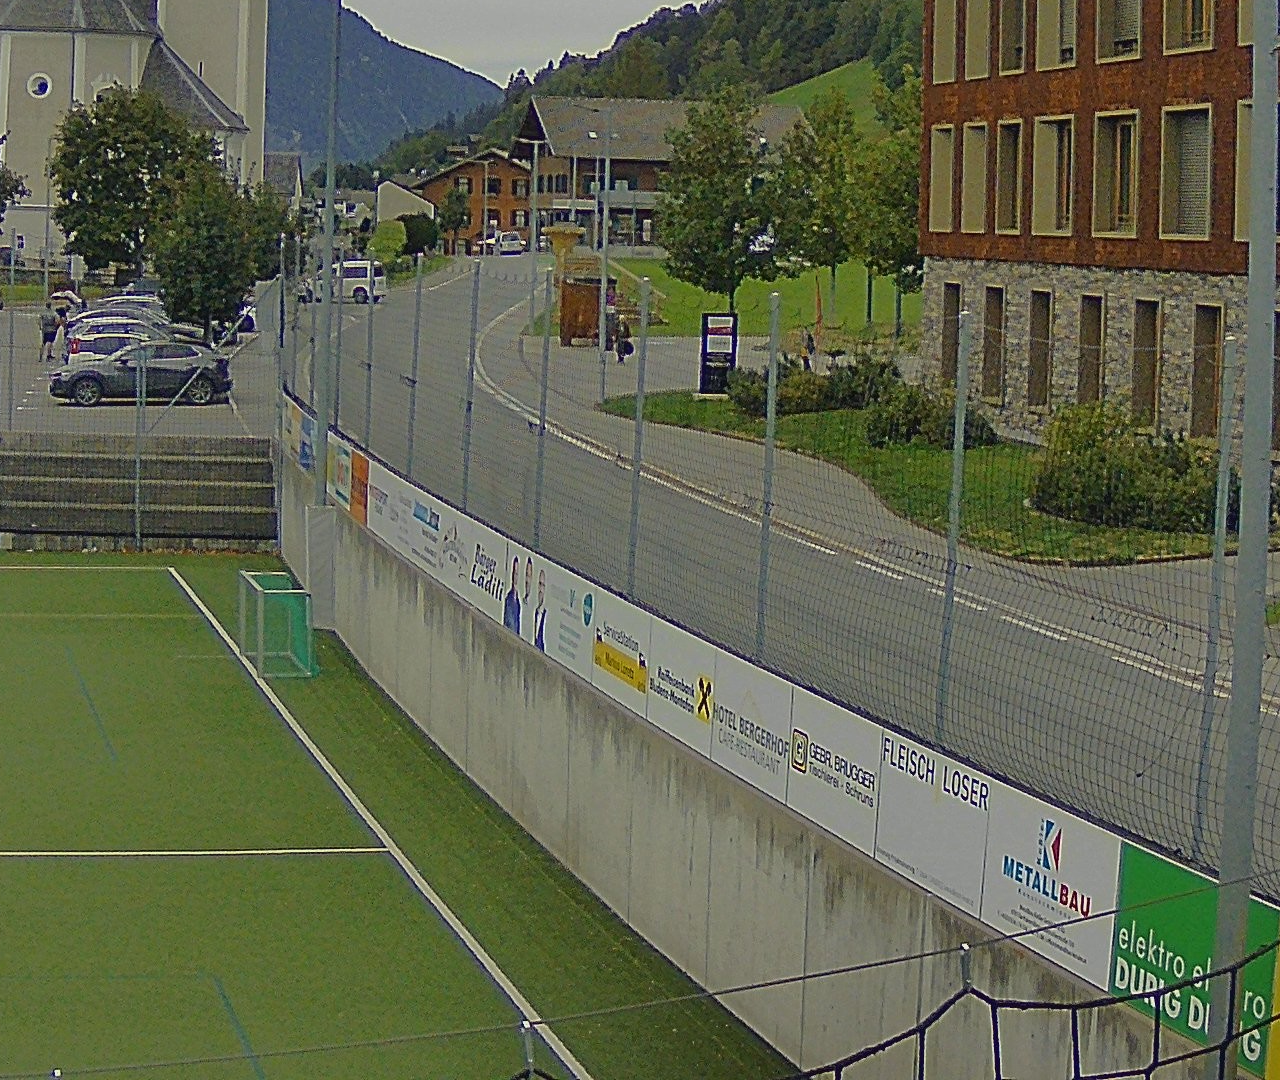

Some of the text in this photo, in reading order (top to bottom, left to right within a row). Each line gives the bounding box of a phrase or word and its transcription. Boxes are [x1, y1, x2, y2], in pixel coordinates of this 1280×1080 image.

[713, 701, 790, 759] HOTEL BERGERHOF
[809, 742, 876, 792] GEBR. BRUGGER
[845, 781, 874, 808] Schruns
[883, 737, 990, 812] FLEISCH LOSER
[1002, 854, 1092, 919] METALLBAU
[1118, 919, 1186, 980] elektro
